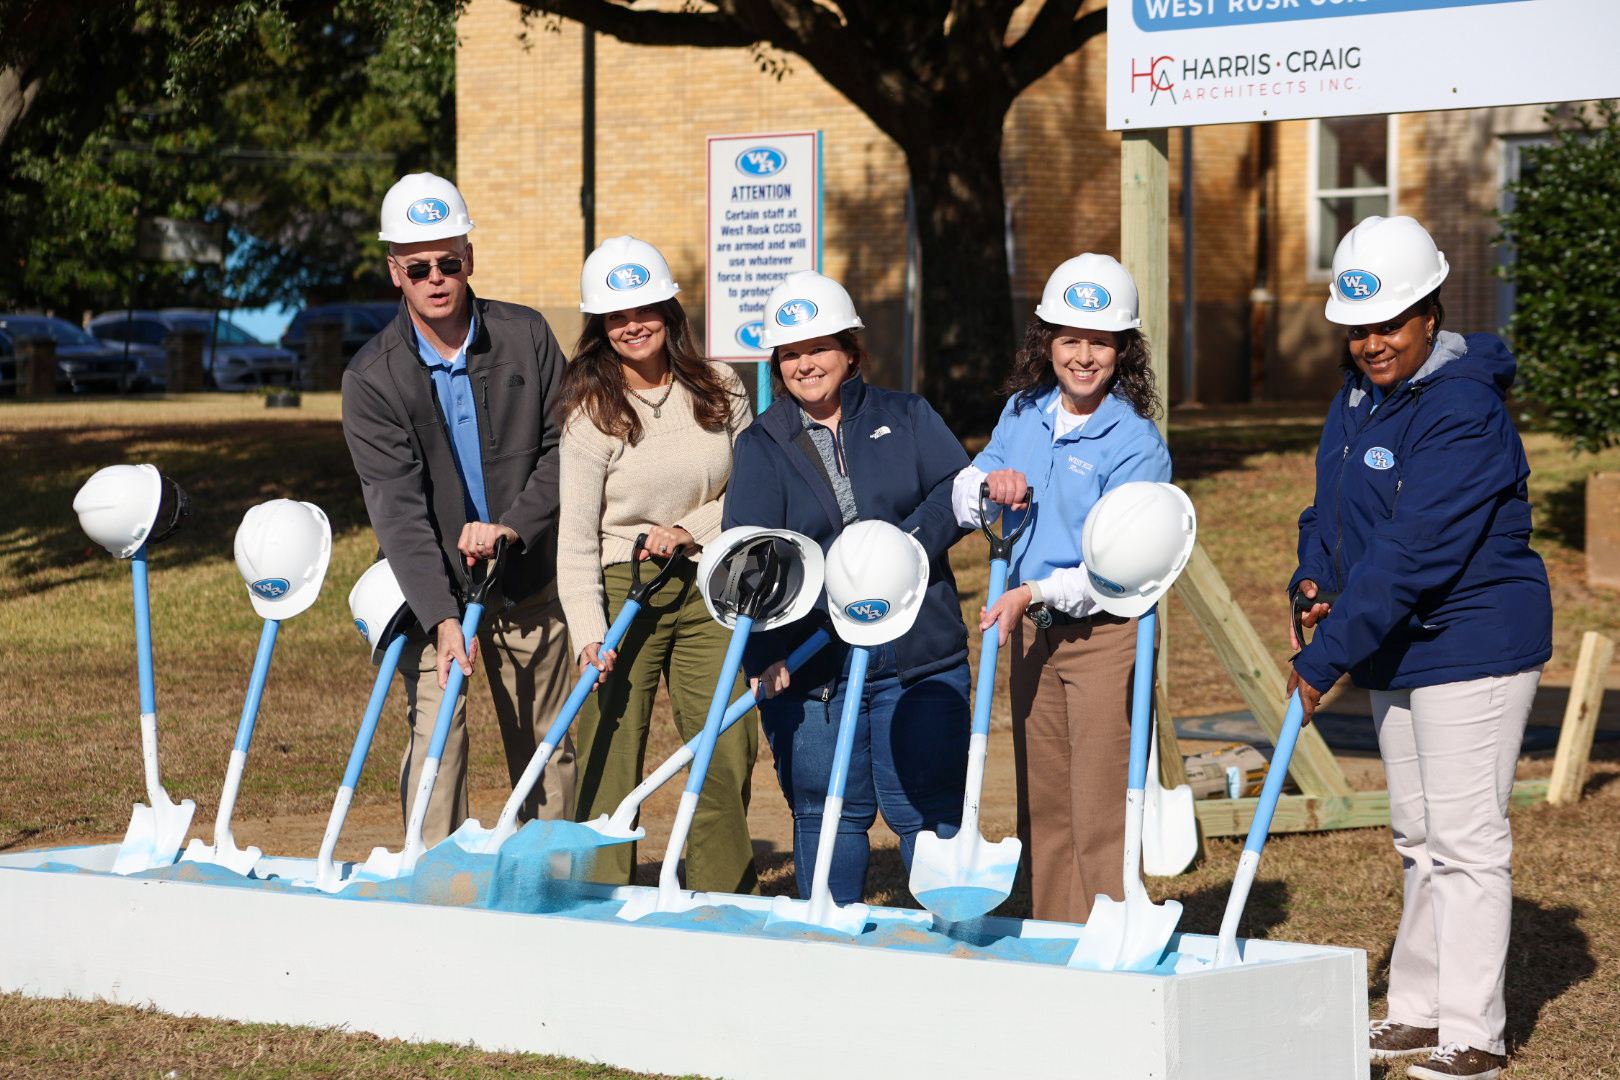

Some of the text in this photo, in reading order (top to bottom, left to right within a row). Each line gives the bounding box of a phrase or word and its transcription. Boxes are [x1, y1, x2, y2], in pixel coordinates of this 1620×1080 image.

[1183, 46, 1361, 81] HARRIS CRAIG
[1183, 77, 1361, 101] ARCHITECTS INC.
[747, 151, 776, 173] WR
[731, 184, 791, 201] ATTENTION
[414, 202, 442, 221] WR
[725, 207, 797, 221] Certain staff at
[721, 222, 802, 236] West Rusk CCISD
[717, 238, 806, 252] are armed and will
[729, 255, 793, 267] use whatever
[613, 267, 643, 287] WR
[717, 271, 741, 283] force
[745, 271, 753, 282] is
[728, 287, 737, 298] to
[1342, 275, 1371, 297] WR
[1073, 286, 1100, 309] WR
[739, 301, 765, 312] stude
[1370, 450, 1388, 468] WR
[255, 582, 285, 597] WR
[850, 604, 883, 620] WR
